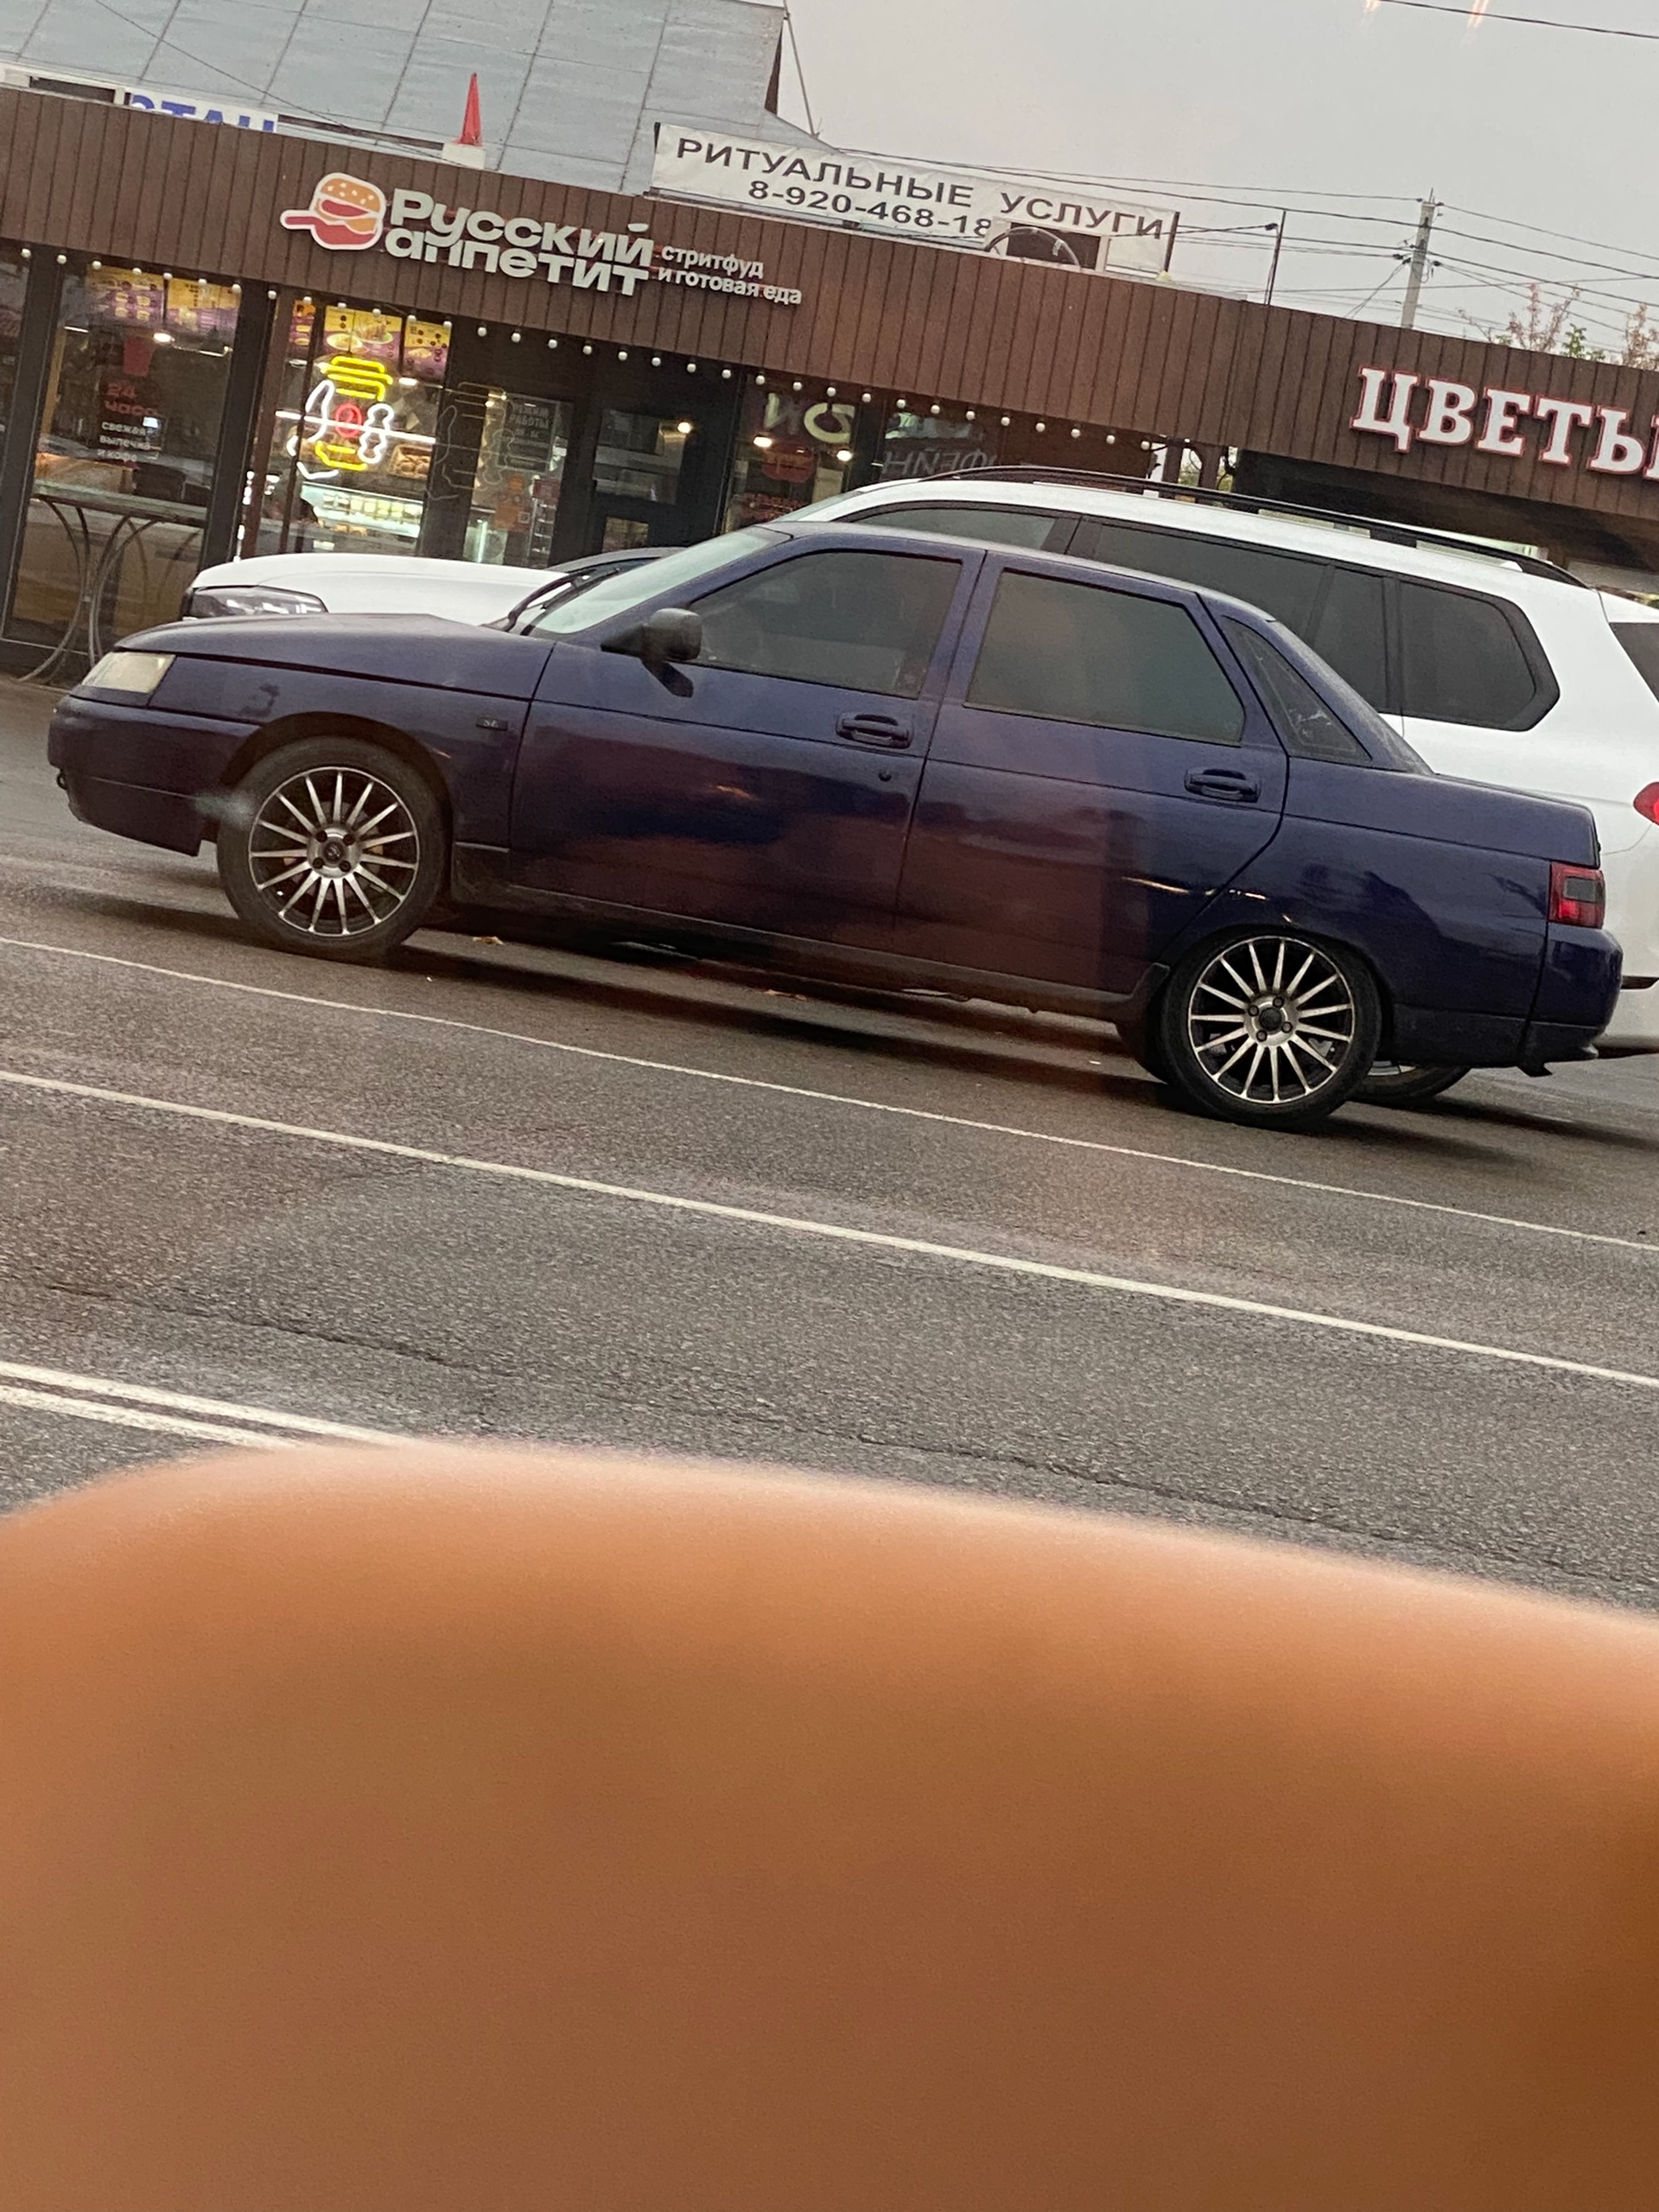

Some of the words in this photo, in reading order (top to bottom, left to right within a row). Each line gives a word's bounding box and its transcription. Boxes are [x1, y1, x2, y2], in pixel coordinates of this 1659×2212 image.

[676, 137, 972, 208] РИТУАЛЬНЫЕ
[1000, 192, 1163, 240] УСЛУГИ
[385, 227, 649, 296] аппетит
[391, 188, 654, 267] Русский
[661, 245, 764, 279] стритфуд
[658, 267, 672, 283] и
[675, 270, 760, 297] готовая
[763, 285, 802, 305] еда
